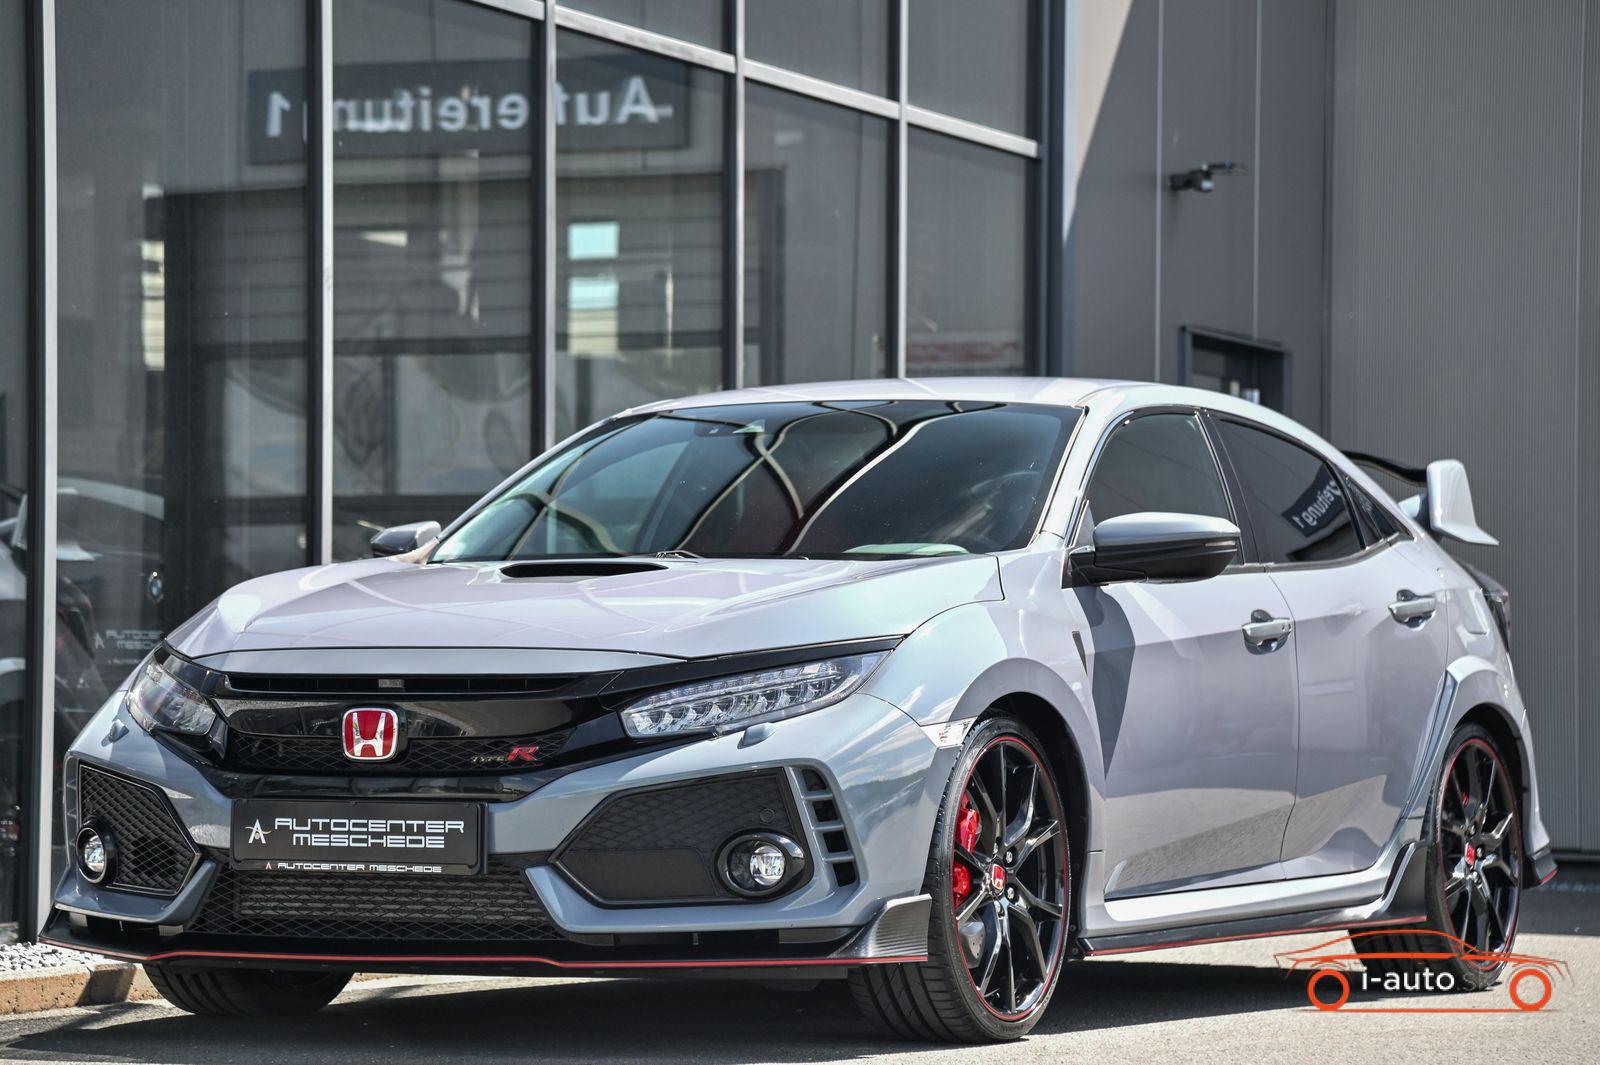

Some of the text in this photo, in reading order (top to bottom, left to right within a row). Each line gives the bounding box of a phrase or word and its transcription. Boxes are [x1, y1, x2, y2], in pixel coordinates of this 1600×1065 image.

[508, 745, 540, 762] R
[274, 817, 465, 833] AUTOCENTER
[292, 833, 445, 849] MESCHEDE
[277, 862, 365, 872] AUTOCENTER
[369, 864, 442, 873] MESCHEDE
